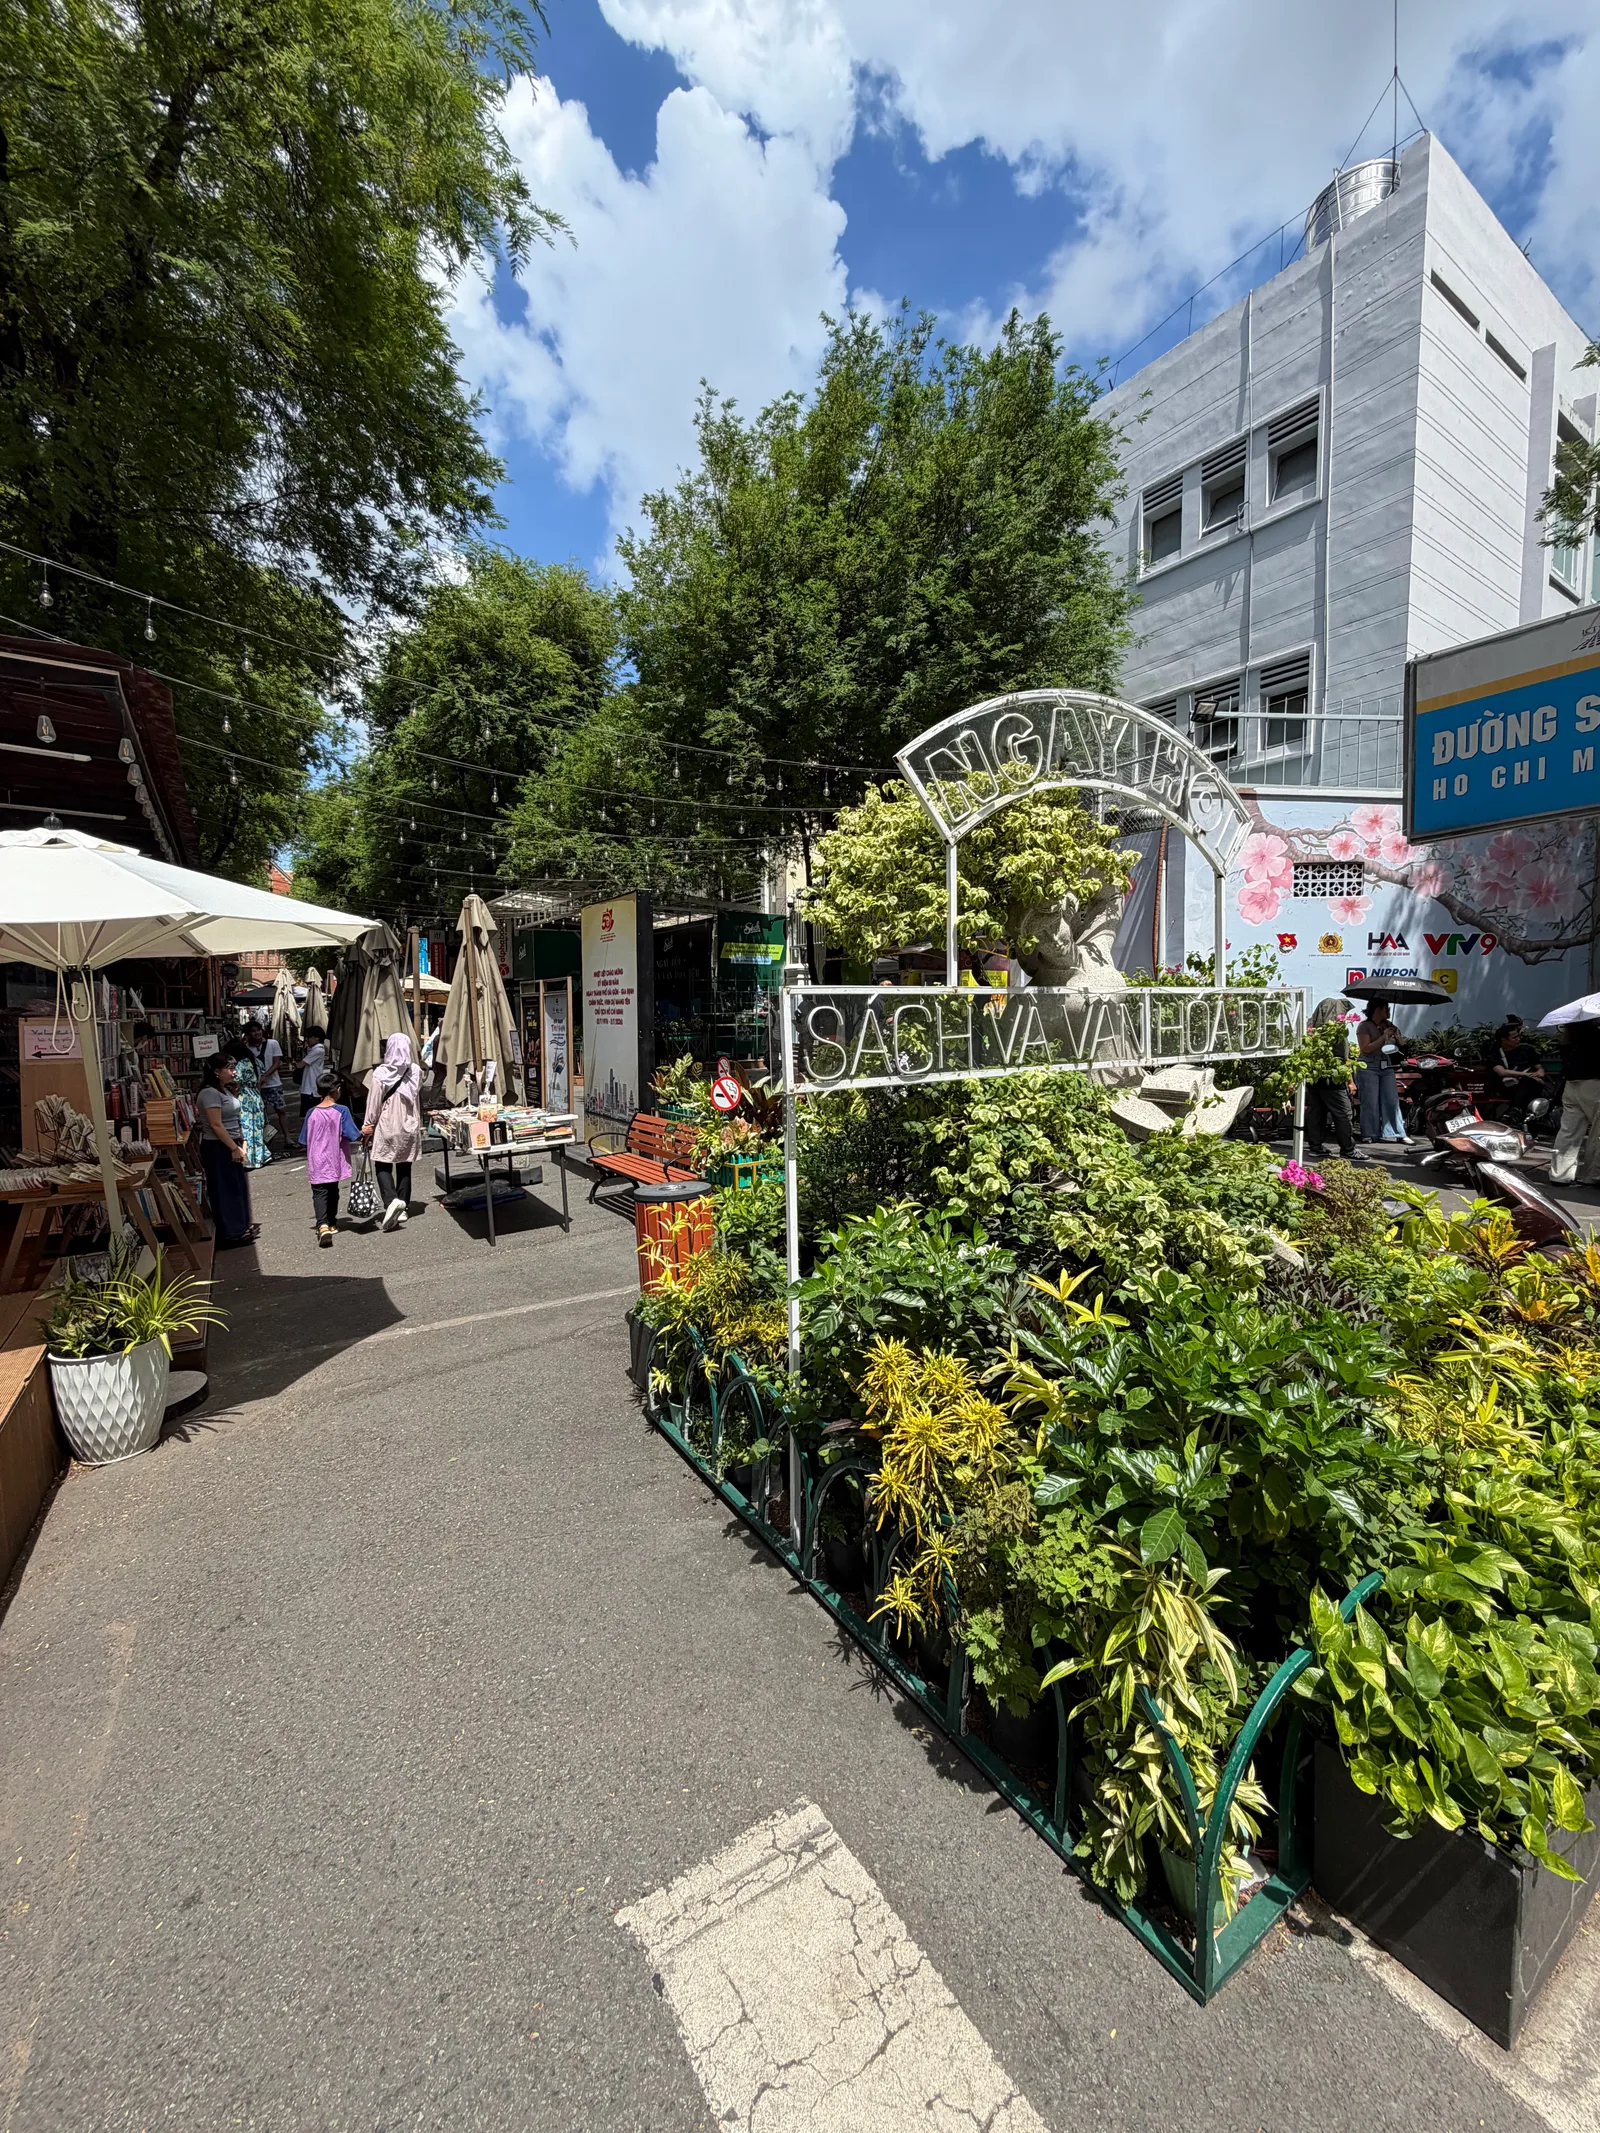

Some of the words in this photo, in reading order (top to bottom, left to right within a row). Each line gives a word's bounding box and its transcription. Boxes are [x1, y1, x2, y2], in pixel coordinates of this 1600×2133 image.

[925, 693, 1131, 823] NGÀY
[1432, 705, 1557, 766] ĐƯỜNG
[1432, 773, 1468, 801] HO
[1491, 756, 1546, 789] CHI
[1423, 933, 1498, 955] VTV9
[1371, 968, 1418, 977] NIPPON
[804, 993, 972, 1080] SÁCH
[987, 992, 1053, 1064] VÀ
[1061, 994, 1144, 1060] VĂN
[1156, 992, 1232, 1054] HÓA
